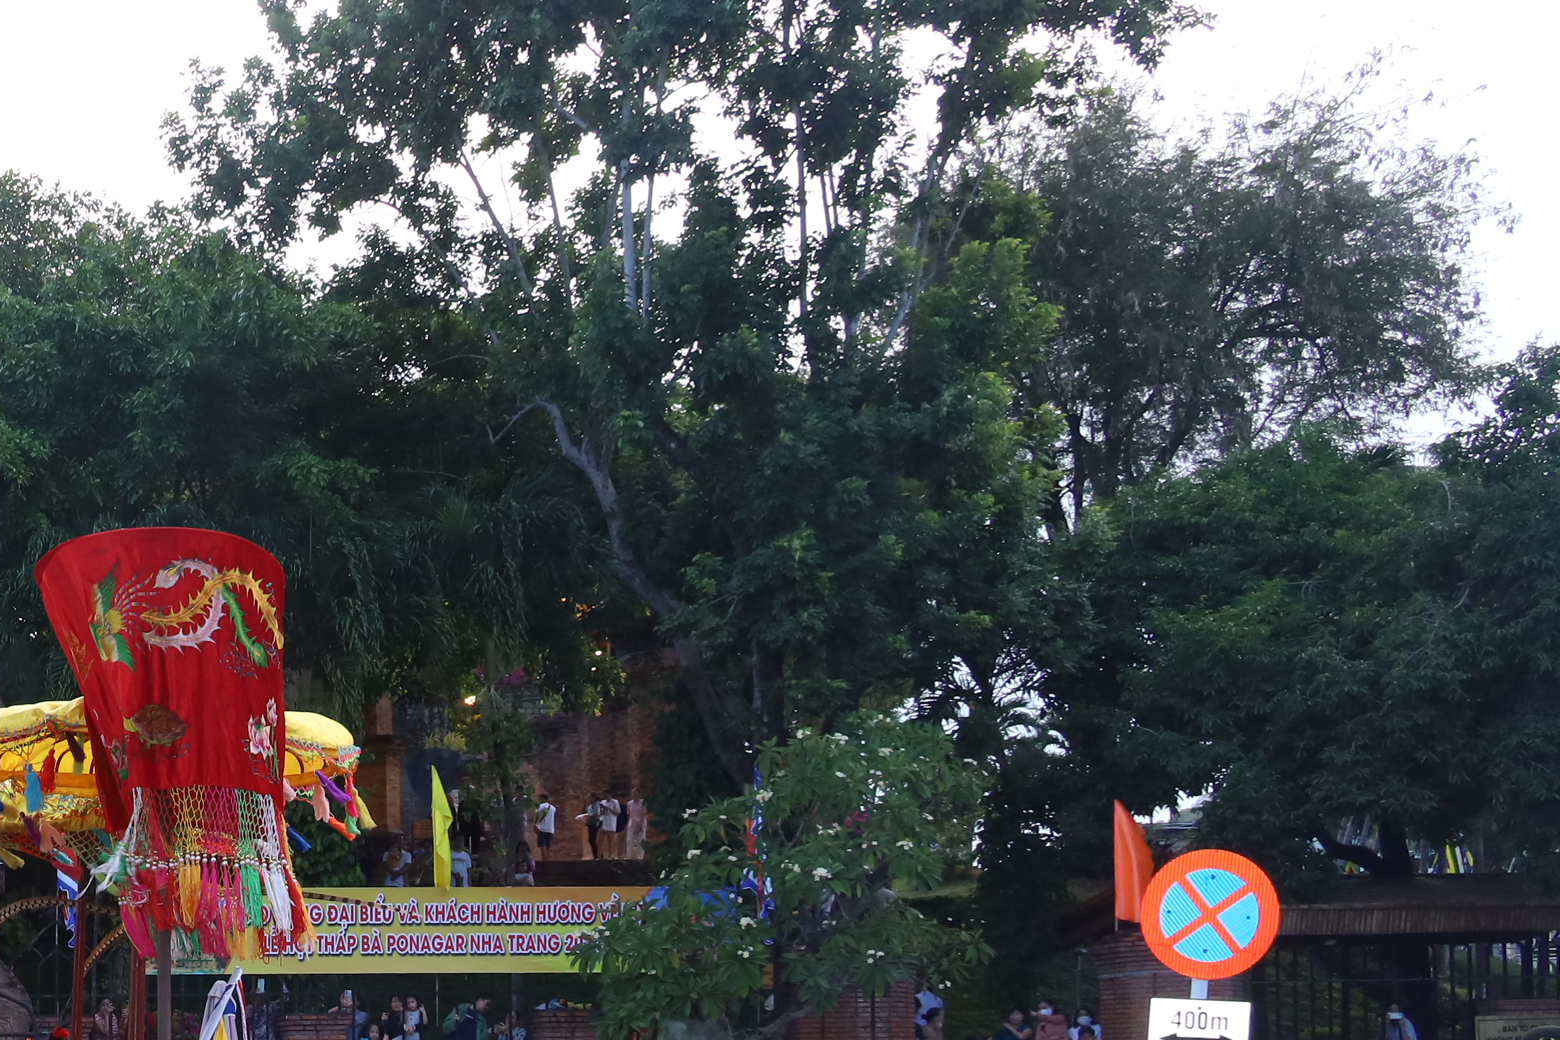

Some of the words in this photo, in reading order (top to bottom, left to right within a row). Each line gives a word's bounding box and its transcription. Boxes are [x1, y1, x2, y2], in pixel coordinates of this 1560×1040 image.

[327, 903, 356, 931] ĐẠI
[397, 897, 421, 924] VÀ
[423, 897, 482, 924] KHÁCH
[485, 897, 532, 924] HÀNH
[535, 900, 596, 925] HƯƠNG
[316, 928, 357, 955] THÁP
[360, 928, 384, 955] BÀ
[386, 932, 466, 955] PONAGAR
[469, 932, 505, 955] NHA
[507, 932, 561, 955] TRANG
[1171, 1011, 1228, 1030] 400m
